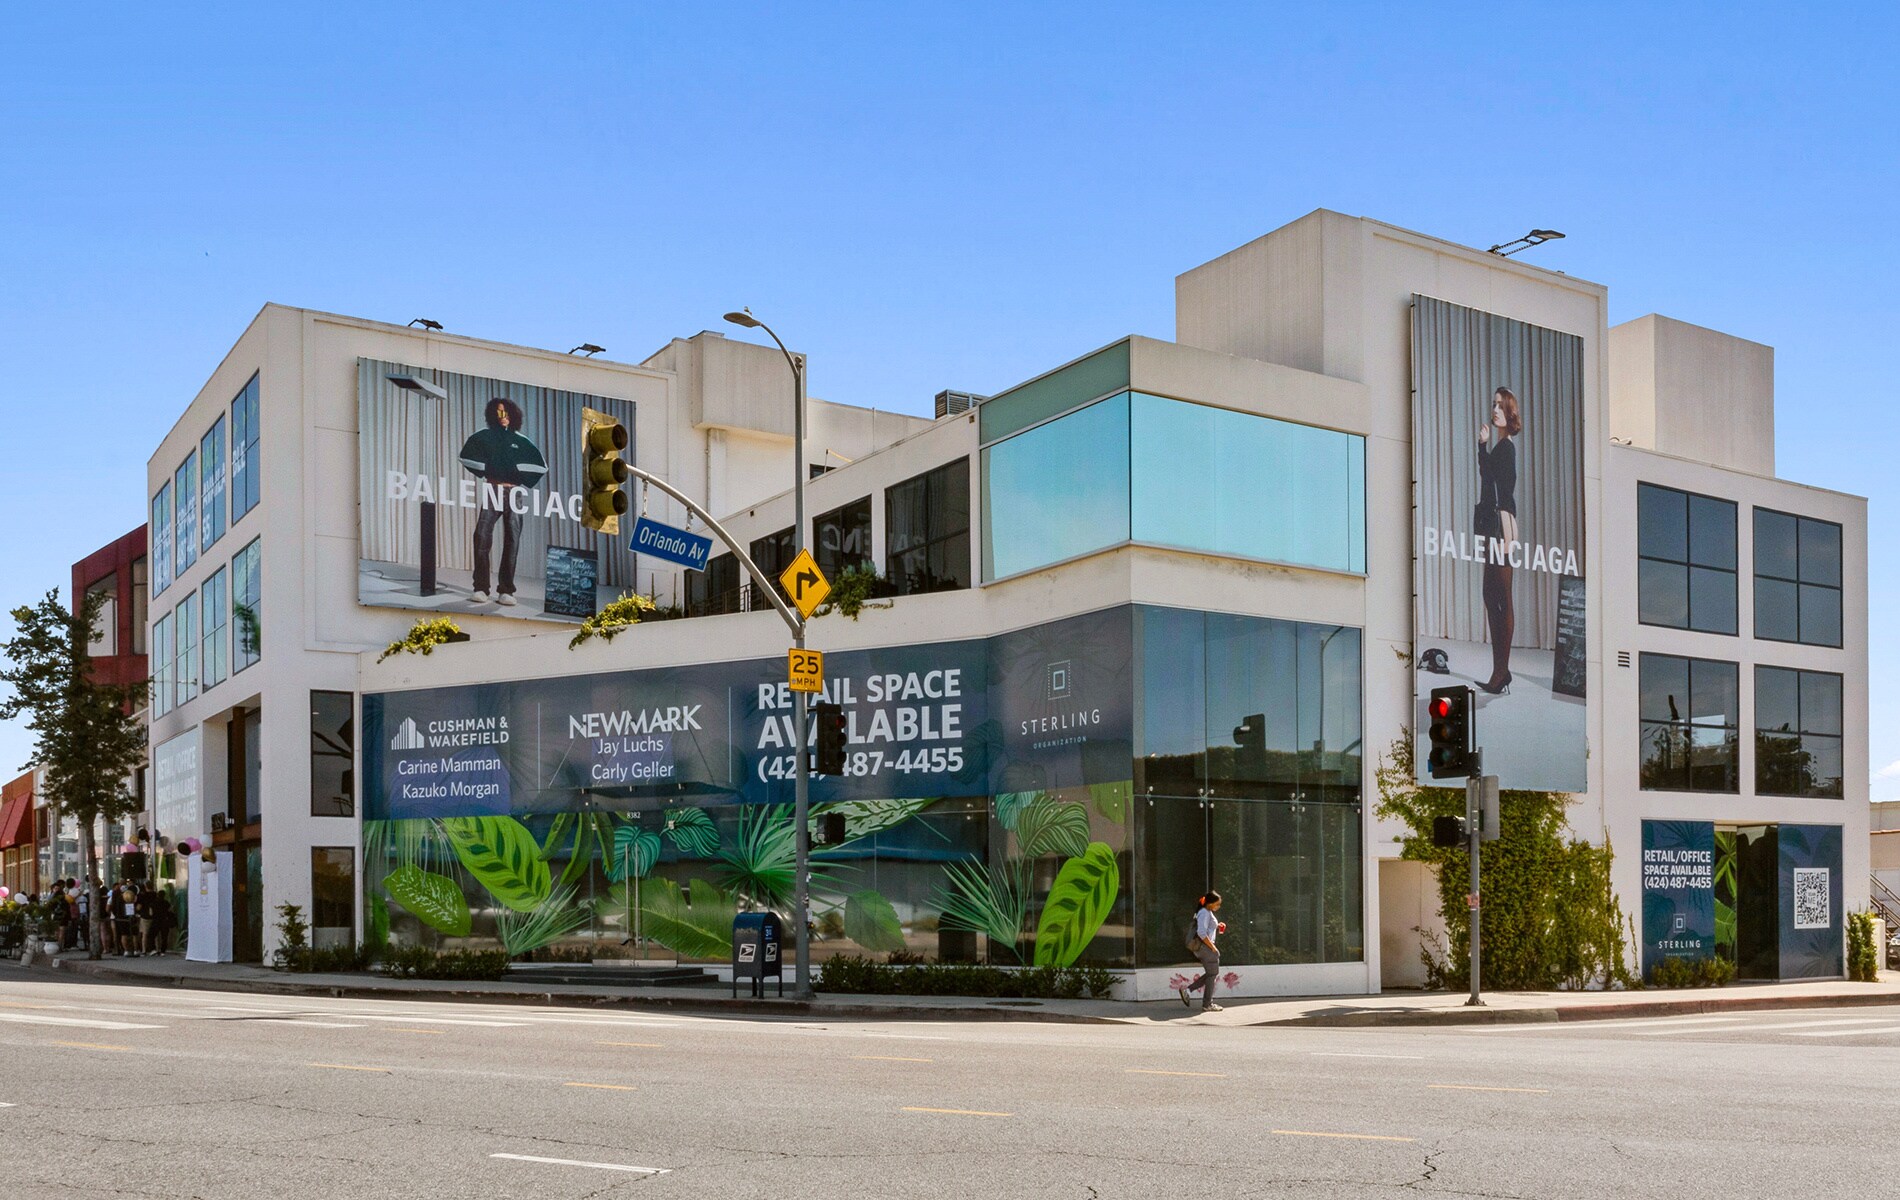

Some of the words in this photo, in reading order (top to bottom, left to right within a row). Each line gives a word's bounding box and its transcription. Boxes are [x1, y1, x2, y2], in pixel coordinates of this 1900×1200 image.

[387, 470, 583, 522] BALENCIAG
[639, 526, 687, 556] Orlando
[688, 542, 705, 560] Av
[1424, 526, 1579, 577] BALENCIAGA
[793, 655, 819, 675] 25
[758, 677, 857, 710] REAIL
[866, 669, 961, 703] SPACE
[797, 678, 816, 687] MPH
[428, 717, 495, 734] CUSHMAN
[499, 715, 509, 729] &
[569, 704, 702, 739] NEWMARK
[1021, 708, 1100, 736] STERLING
[428, 731, 510, 748] WAKEFIELD
[597, 738, 620, 757] Jay
[623, 736, 664, 753] Luchs
[1032, 735, 1087, 750] ORGANIZATION
[398, 759, 438, 775] Carine
[440, 757, 501, 773] Mamman
[591, 763, 628, 782] Carly
[631, 761, 674, 779] Geller
[402, 782, 447, 799] Kazuko
[450, 781, 499, 799] Morgan
[1644, 849, 1711, 864] RETAIL/OFFICE
[1644, 864, 1669, 876] SPACE
[1670, 865, 1711, 876] AVAILABLE
[1644, 876, 1669, 889] (424)
[1670, 876, 1712, 889] 487-4455
[1658, 939, 1701, 949] STERLING
